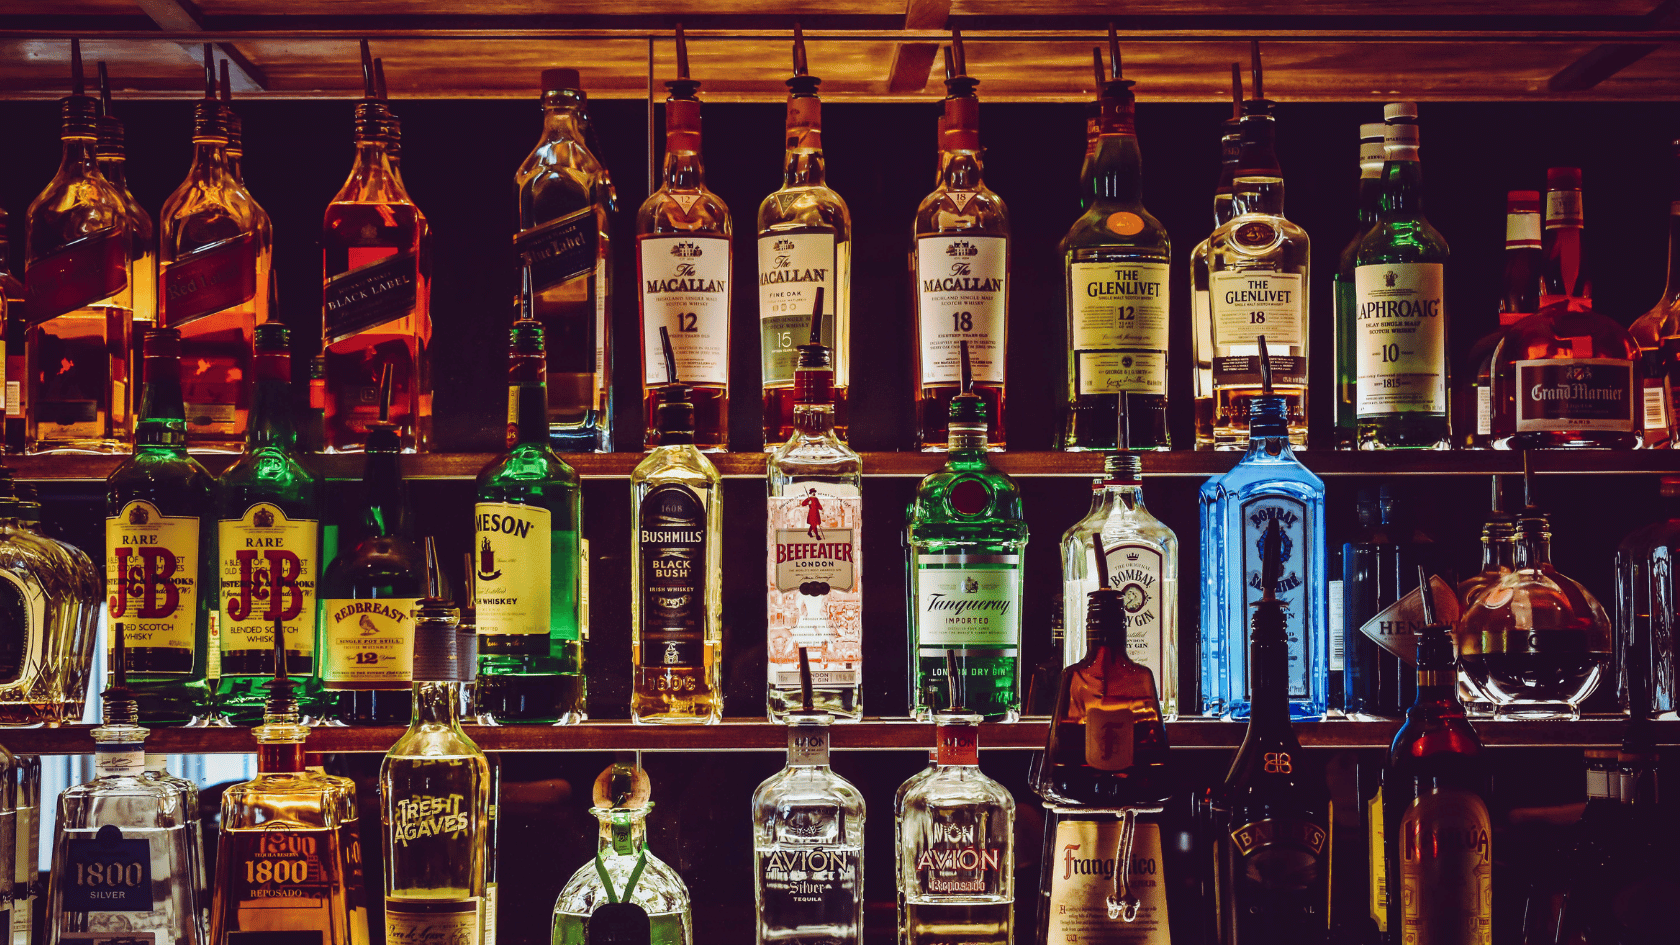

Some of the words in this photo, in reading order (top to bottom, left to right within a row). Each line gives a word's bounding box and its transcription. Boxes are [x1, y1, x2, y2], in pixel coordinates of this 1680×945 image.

[680, 196, 691, 204] 12
[956, 193, 967, 202] 18
[550, 231, 587, 256] Label
[773, 255, 791, 270] The
[949, 262, 972, 277] The
[674, 263, 696, 278] The
[1115, 270, 1138, 281] THE
[647, 278, 726, 294] MACALLAN
[923, 278, 1003, 293] MACALLAN
[1087, 281, 1161, 298] GLENLIVET
[1247, 280, 1269, 290] THE
[328, 290, 368, 311] BLACK
[372, 275, 410, 295] LABEL
[1225, 290, 1292, 304] GLENLIVET
[1118, 306, 1135, 321] 12
[1249, 311, 1266, 324] 18
[677, 312, 698, 334] 12
[952, 311, 973, 333] 18
[1404, 320, 1421, 328] MALT
[777, 331, 792, 348] 15
[1381, 343, 1400, 363] 10
[1383, 378, 1401, 389] 1815
[1531, 383, 1571, 402] Grand
[1570, 383, 1623, 401] Marnier
[661, 504, 683, 513] 1608
[1250, 506, 1299, 530] BOMBAY
[475, 513, 530, 539] MESON
[122, 534, 158, 545] RARE
[245, 537, 284, 548] RARE
[641, 530, 702, 543] BUSHMILLS
[776, 542, 853, 565] BEEFEATER
[652, 560, 691, 569] BLACK
[1124, 562, 1151, 572] ORIGINAL
[655, 569, 688, 578] BUSH
[1110, 569, 1155, 589] BOMBAY
[109, 546, 180, 619] J&B
[228, 549, 304, 622] J&B
[1250, 573, 1303, 593] SAHIRE
[483, 597, 518, 605] WHISKEY
[927, 592, 1011, 616] Tanqueray
[334, 602, 407, 624] REDBREAST
[1134, 609, 1155, 627] GIN
[138, 623, 174, 632] SCOTCH
[945, 617, 989, 625] IMPORTED
[230, 626, 262, 634] BLENDED
[265, 625, 299, 634] SCTCH
[247, 635, 275, 644] WHISK
[356, 652, 378, 666] 12
[932, 668, 968, 677] LONON
[971, 668, 989, 677] DRY
[992, 668, 1006, 677] GIN
[397, 798, 443, 827] TRES
[394, 811, 469, 848] AGAVES
[1404, 820, 1490, 862] KAÚA
[766, 846, 849, 873] AVIÓN
[916, 845, 1000, 872] AVIÓN
[1063, 844, 1157, 881] Frangico
[76, 862, 143, 887] 1800
[245, 860, 308, 884] 1800
[250, 889, 302, 898] REPOSADO
[788, 880, 826, 895] Silver
[931, 878, 986, 894] Reposado
[90, 891, 127, 899] SILVER
